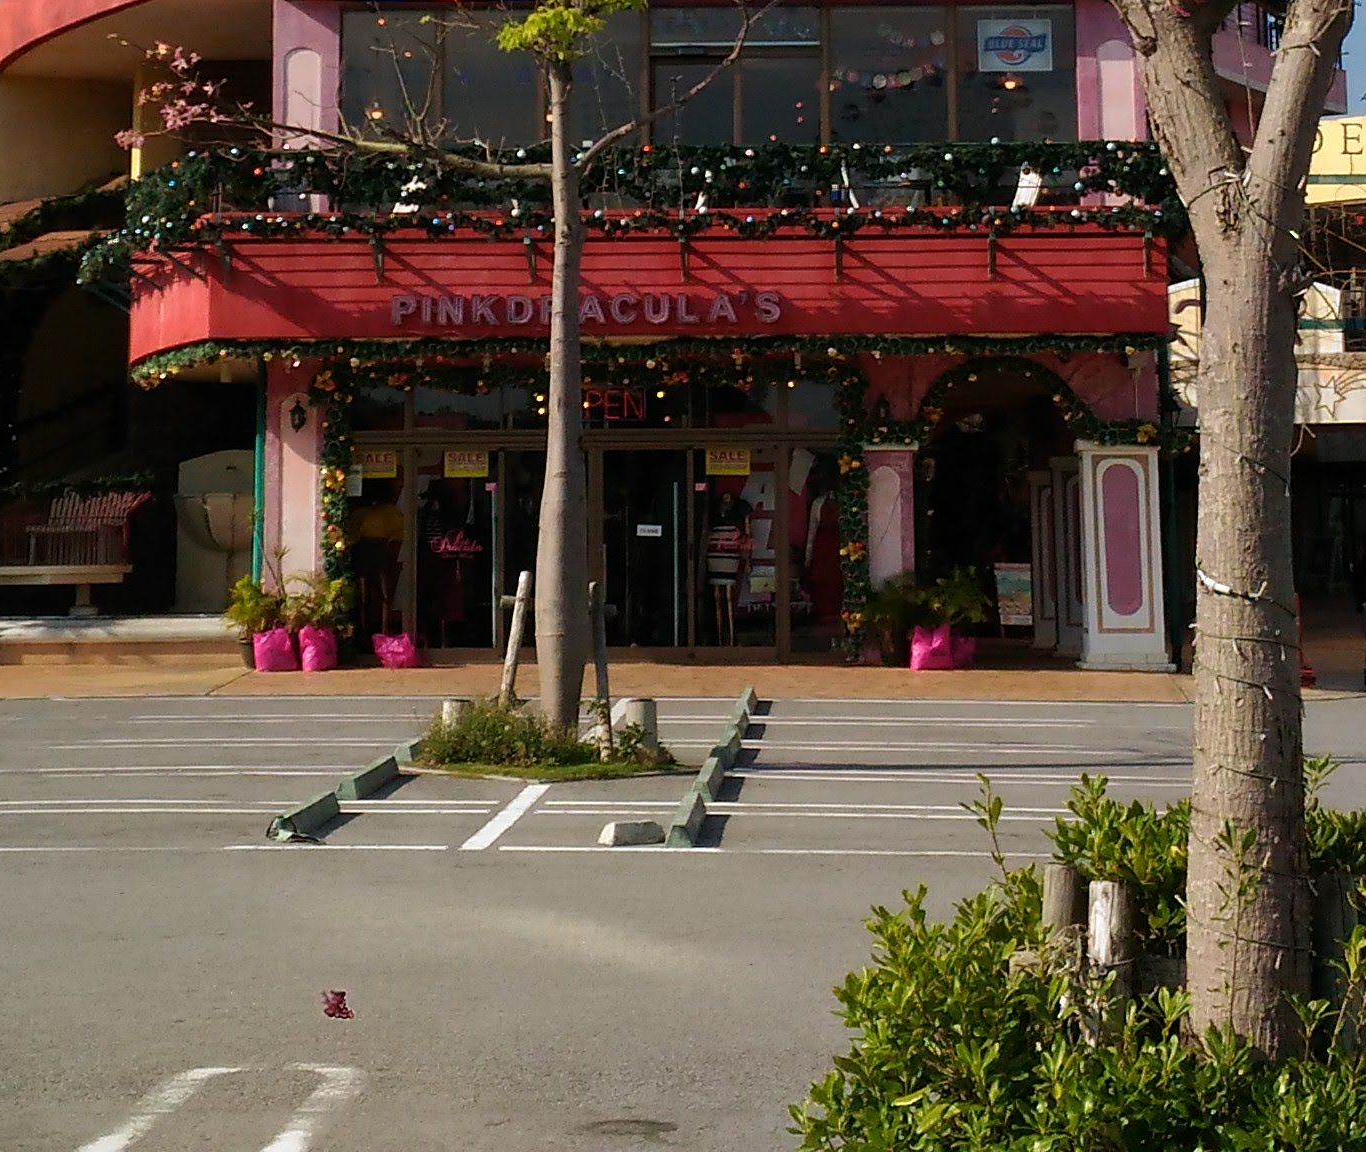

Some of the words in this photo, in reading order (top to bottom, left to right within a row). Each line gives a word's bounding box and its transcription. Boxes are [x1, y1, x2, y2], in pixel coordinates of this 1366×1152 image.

[1018, 39, 1043, 48] SEAL
[585, 389, 644, 420] PEN
[356, 453, 393, 464] SALE
[448, 451, 485, 463] SALE
[709, 451, 746, 461] SALE
